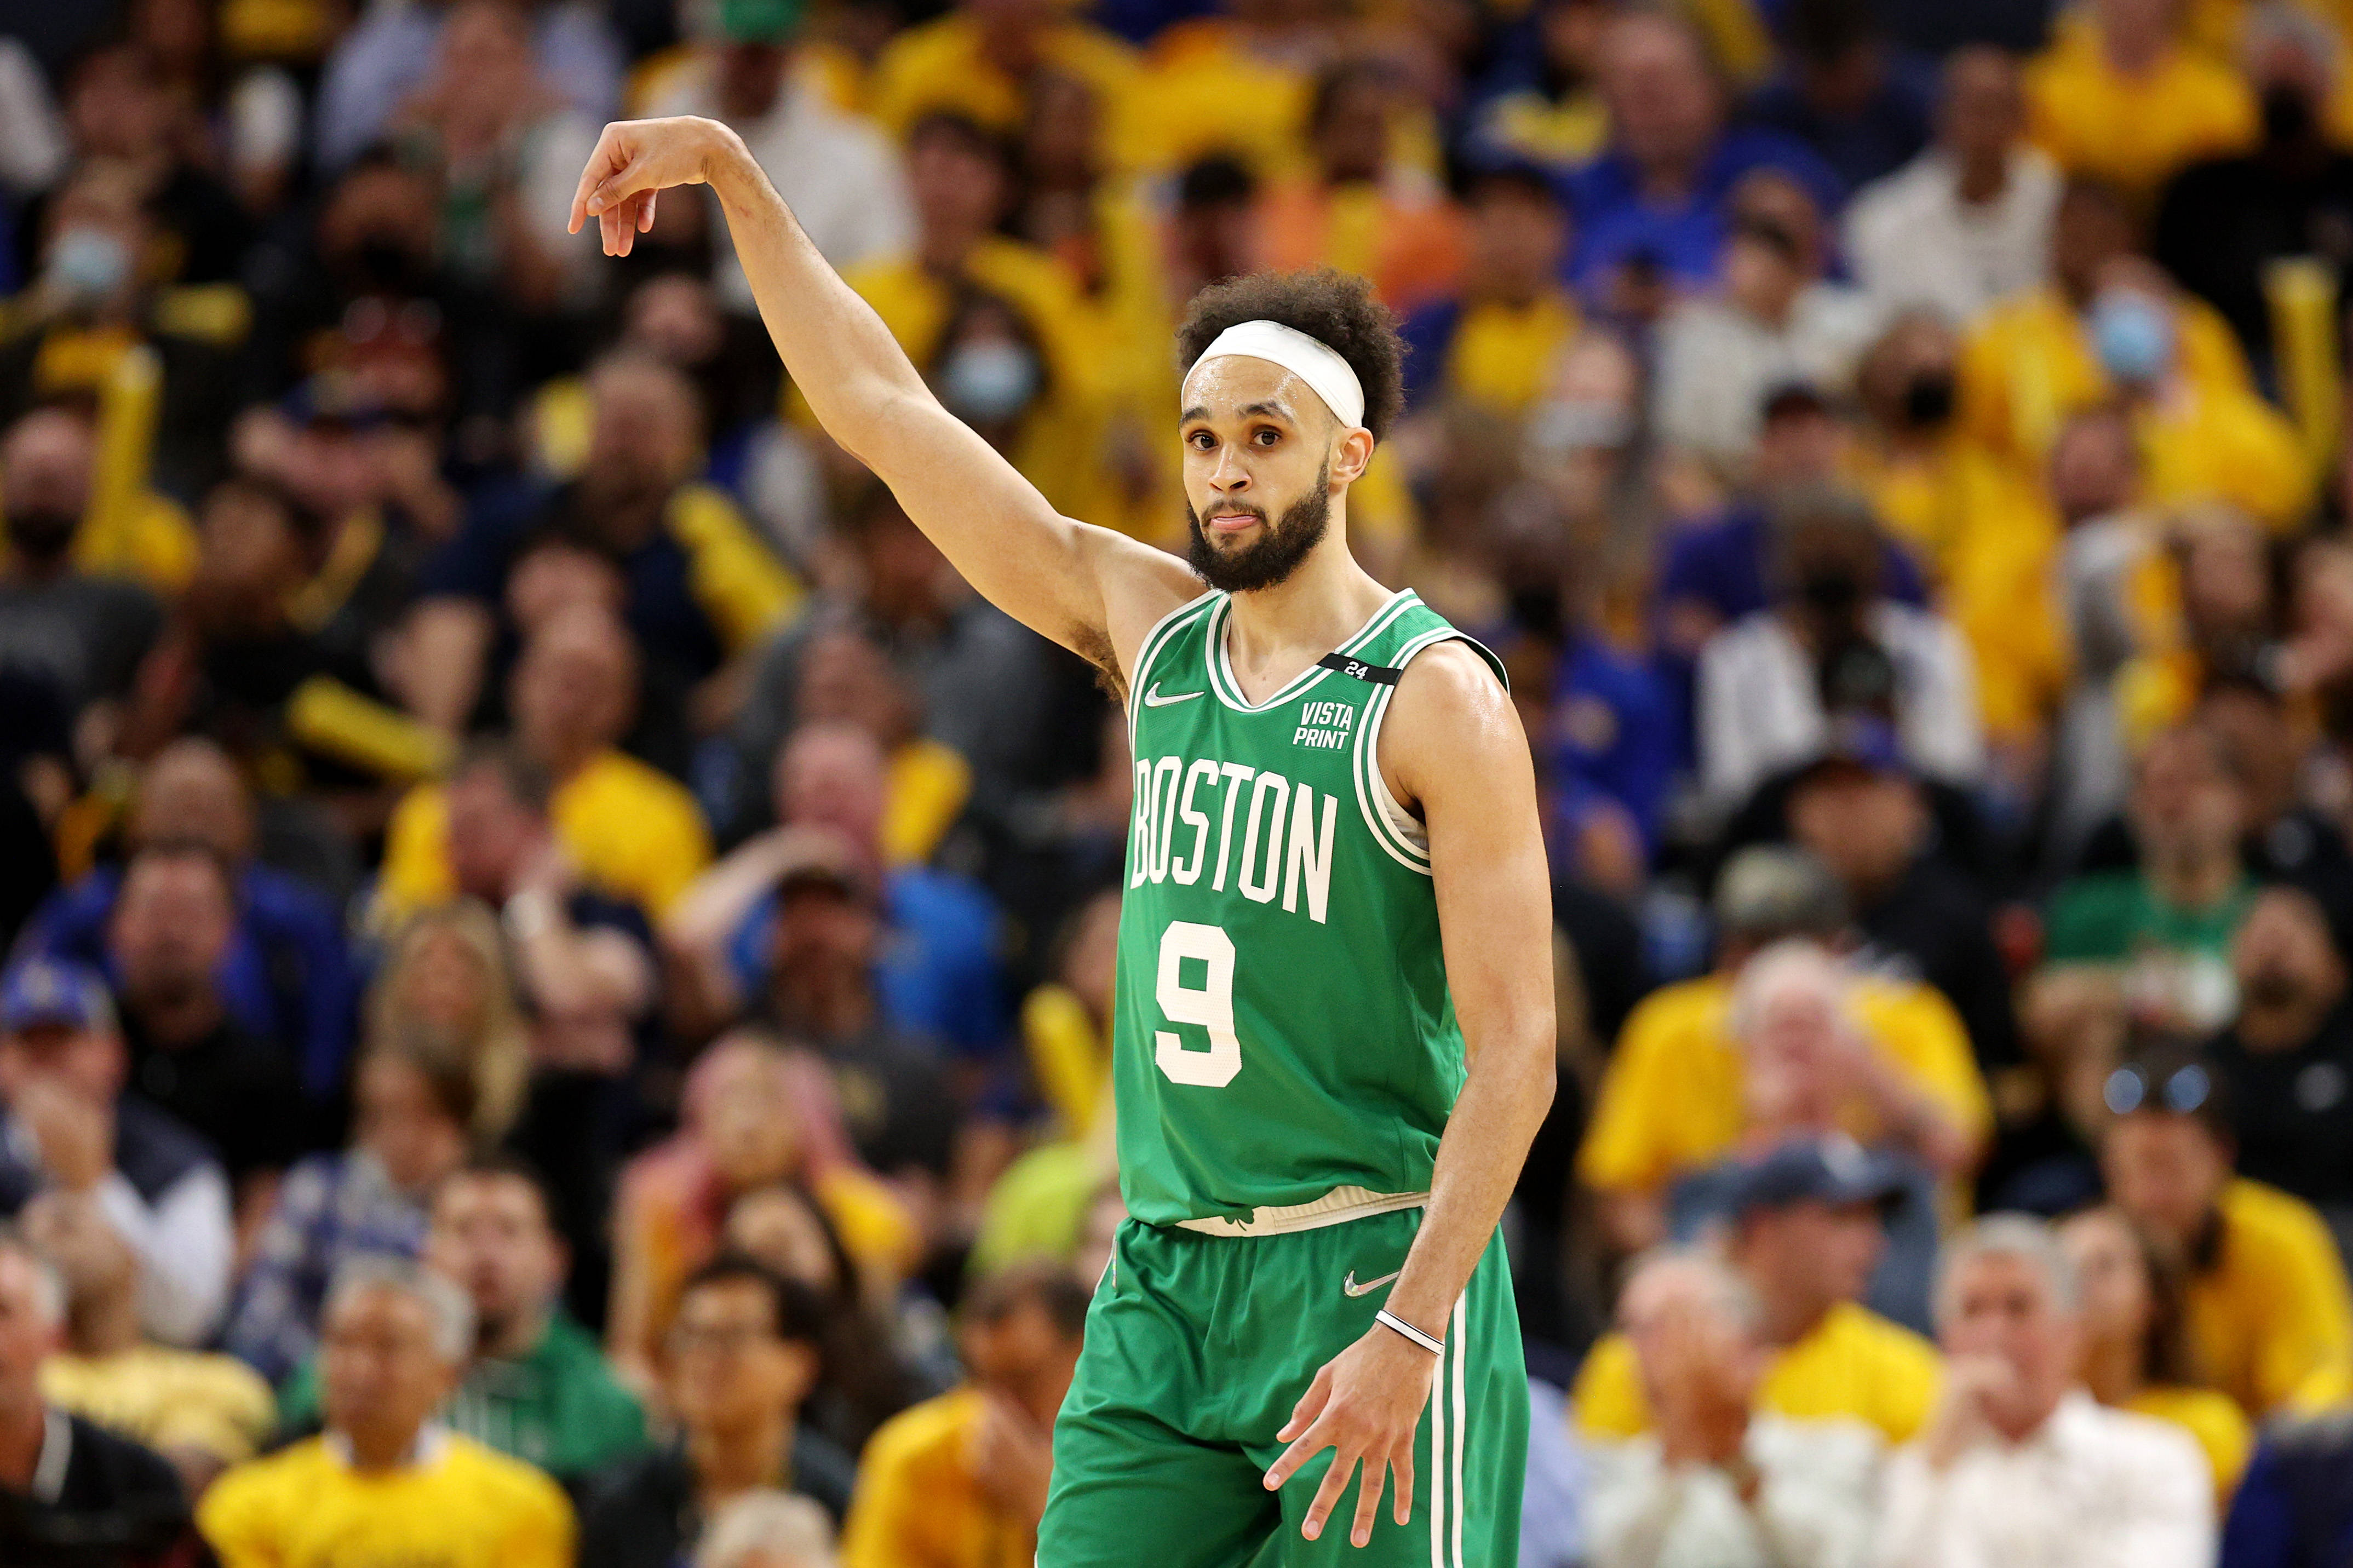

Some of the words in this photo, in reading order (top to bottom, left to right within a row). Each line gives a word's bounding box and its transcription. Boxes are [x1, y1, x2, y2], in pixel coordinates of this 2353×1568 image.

[1344, 660, 1369, 680] 24
[1301, 702, 1353, 731] VISTA
[1293, 727, 1348, 750] PRINT
[1130, 756, 1338, 924] BOSTON
[1155, 920, 1242, 1088] 9
